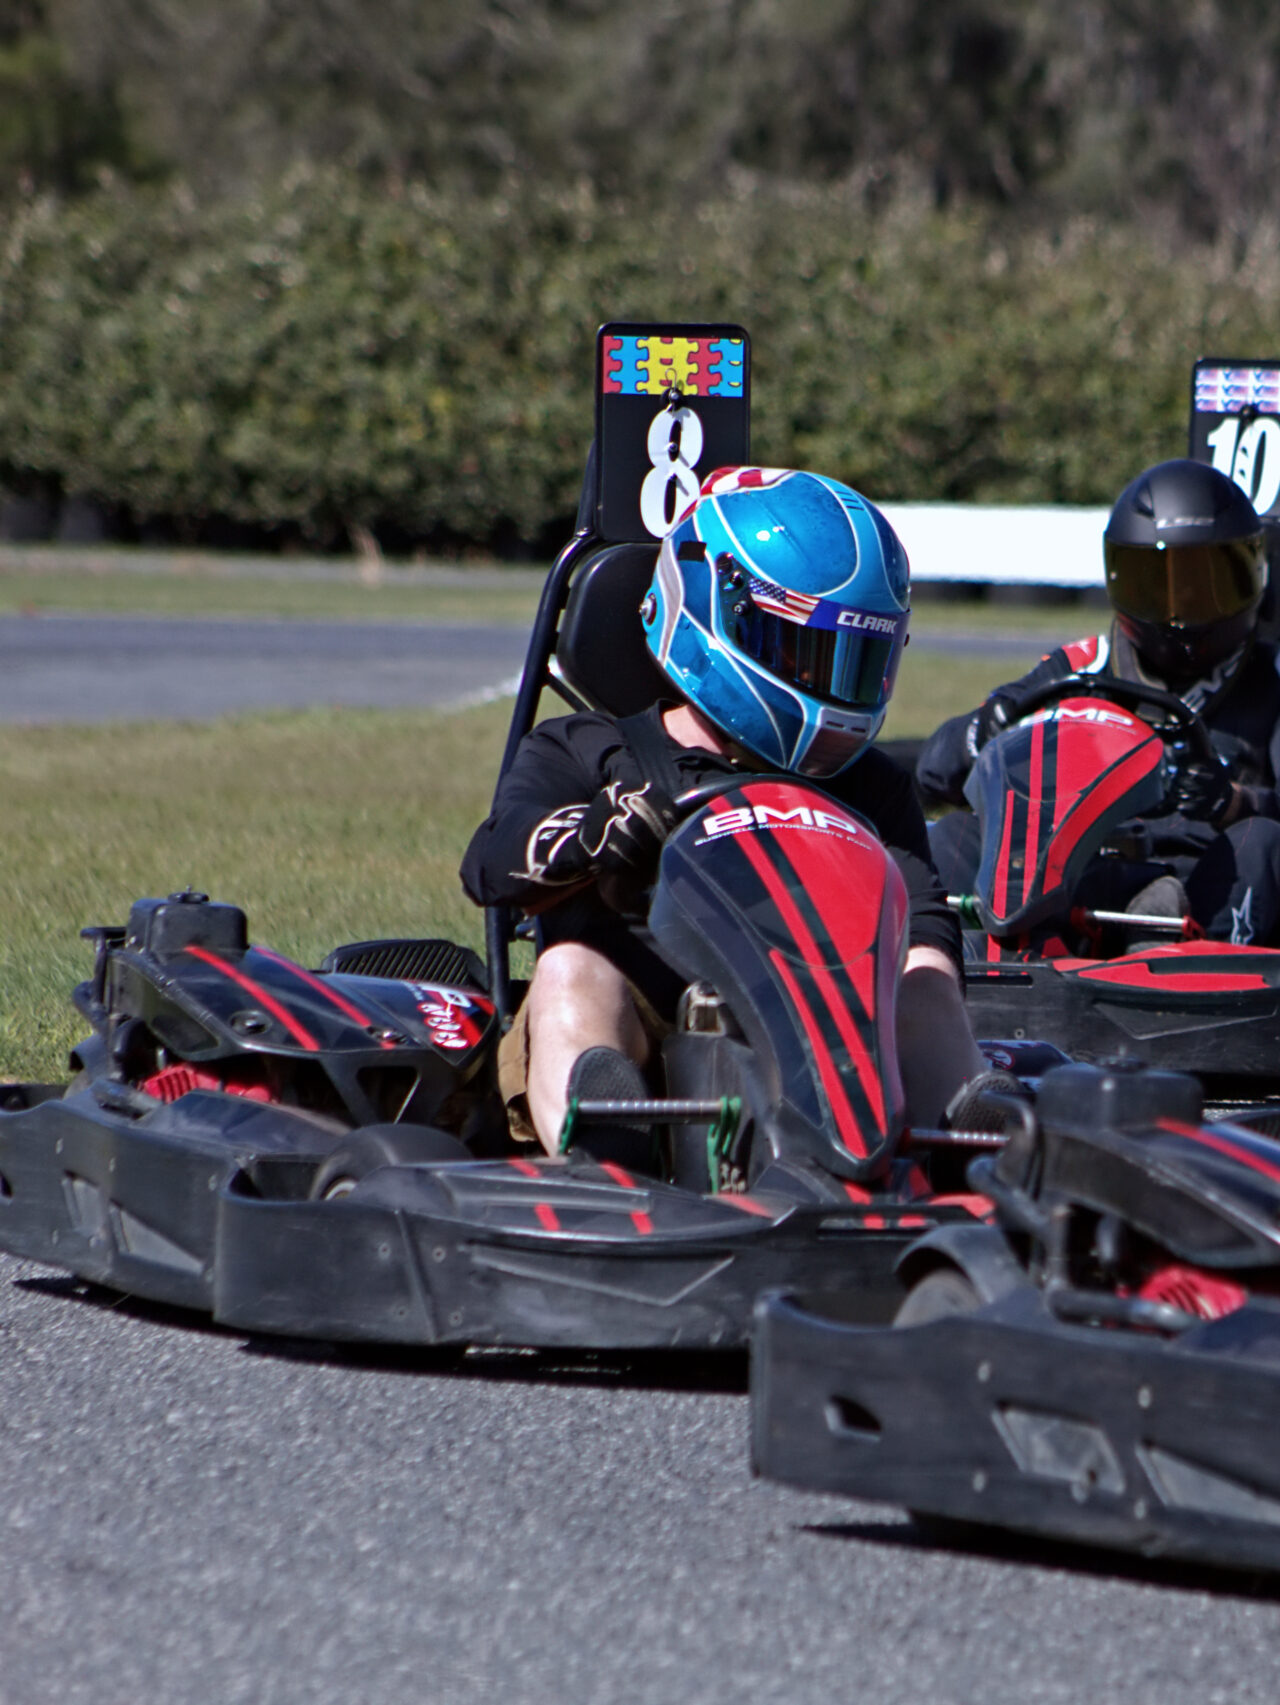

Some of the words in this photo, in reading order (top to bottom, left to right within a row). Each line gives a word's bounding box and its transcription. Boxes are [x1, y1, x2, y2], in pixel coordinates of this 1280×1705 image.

[640, 405, 704, 539] 8
[837, 610, 897, 635] CLARK
[703, 804, 857, 836] BMP
